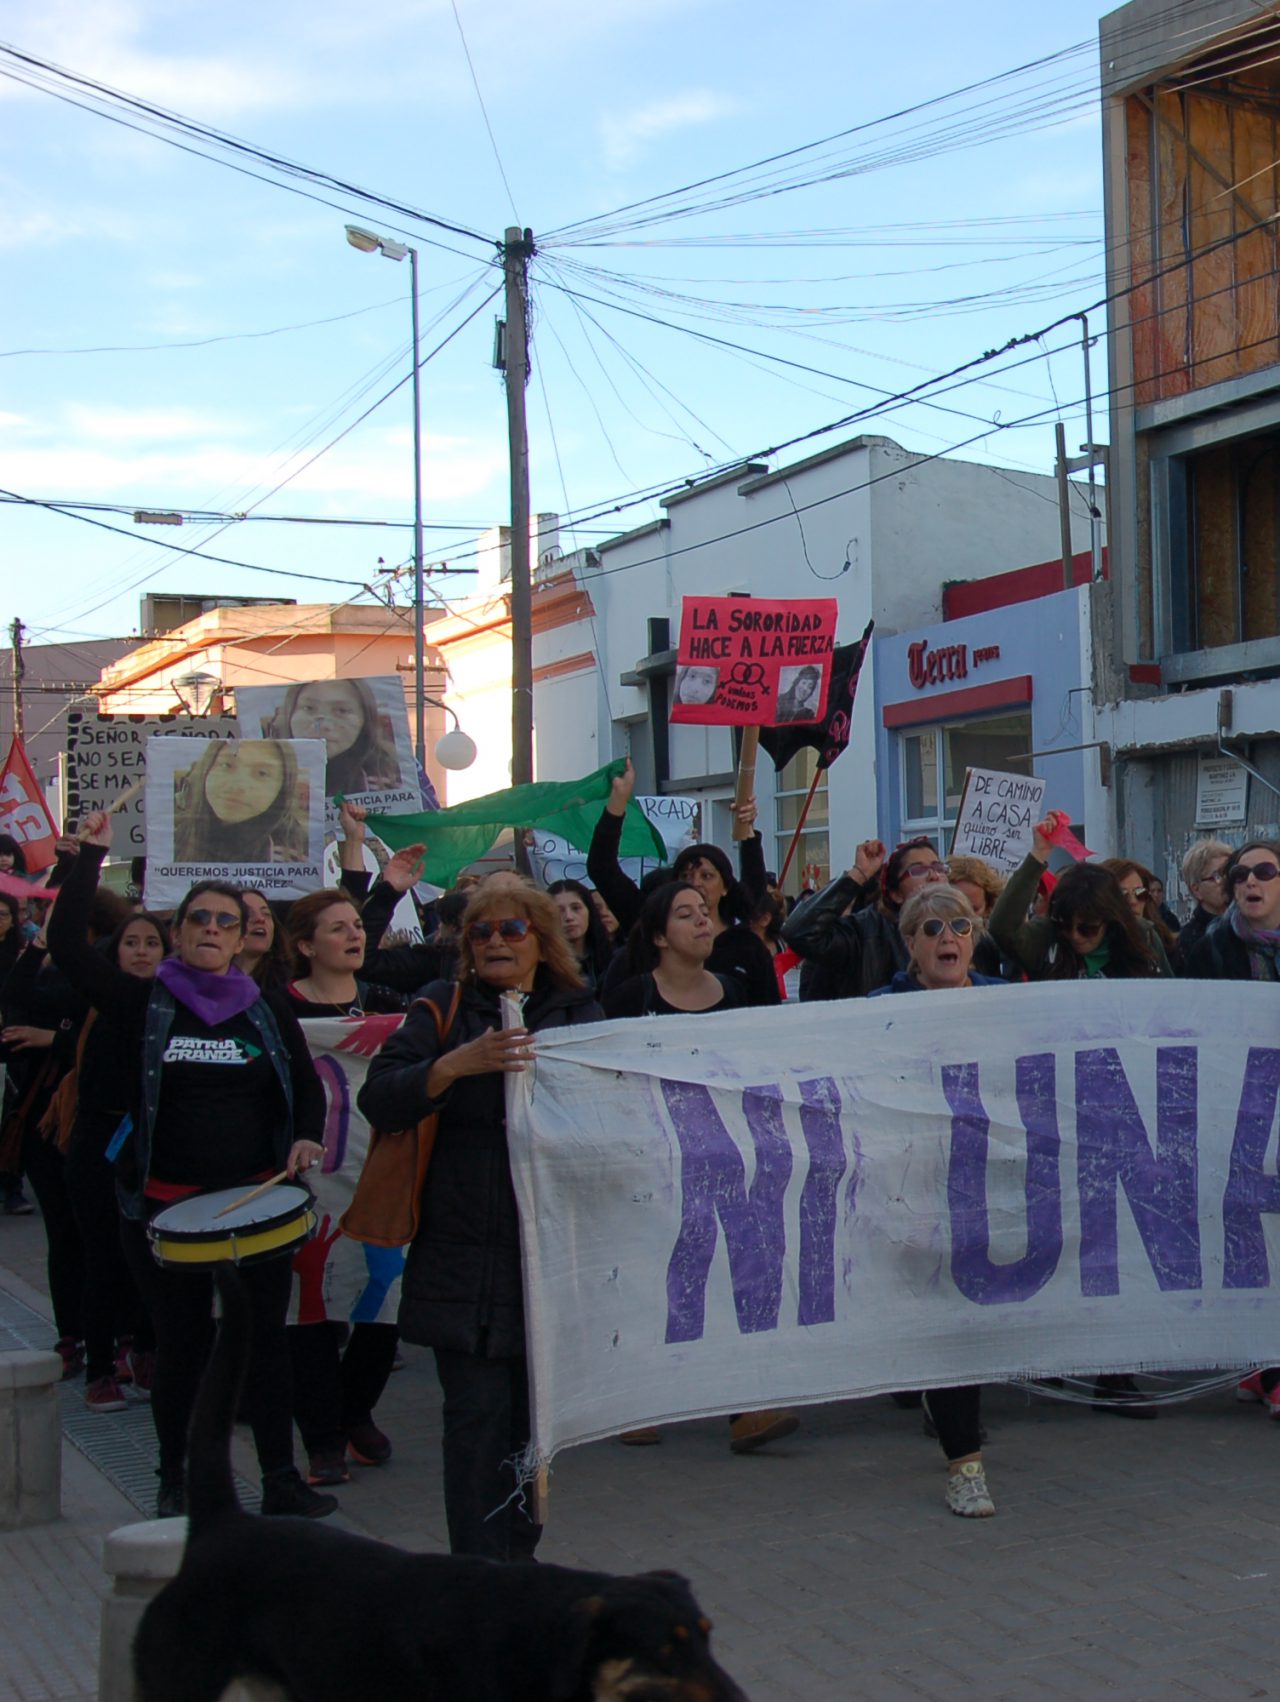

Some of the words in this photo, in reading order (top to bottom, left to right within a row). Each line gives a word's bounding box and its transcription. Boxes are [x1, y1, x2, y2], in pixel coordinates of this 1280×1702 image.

[692, 608, 719, 630] LA
[689, 637, 732, 660] HACE
[740, 636, 753, 658] A
[759, 636, 785, 658] LA
[787, 635, 834, 657] FUERZA
[907, 639, 968, 689] Terra
[77, 751, 102, 767] NO
[80, 773, 98, 790] SE
[974, 775, 994, 795] DE
[384, 792, 415, 803] PARA
[971, 800, 983, 819] A
[987, 801, 1031, 828] CASA
[963, 822, 997, 842] quiero
[1003, 827, 1022, 841] ser
[232, 867, 285, 877] JUSTICIA
[287, 867, 319, 876] PARA
[162, 1049, 244, 1062] GRANDE
[660, 1075, 846, 1345] NI
